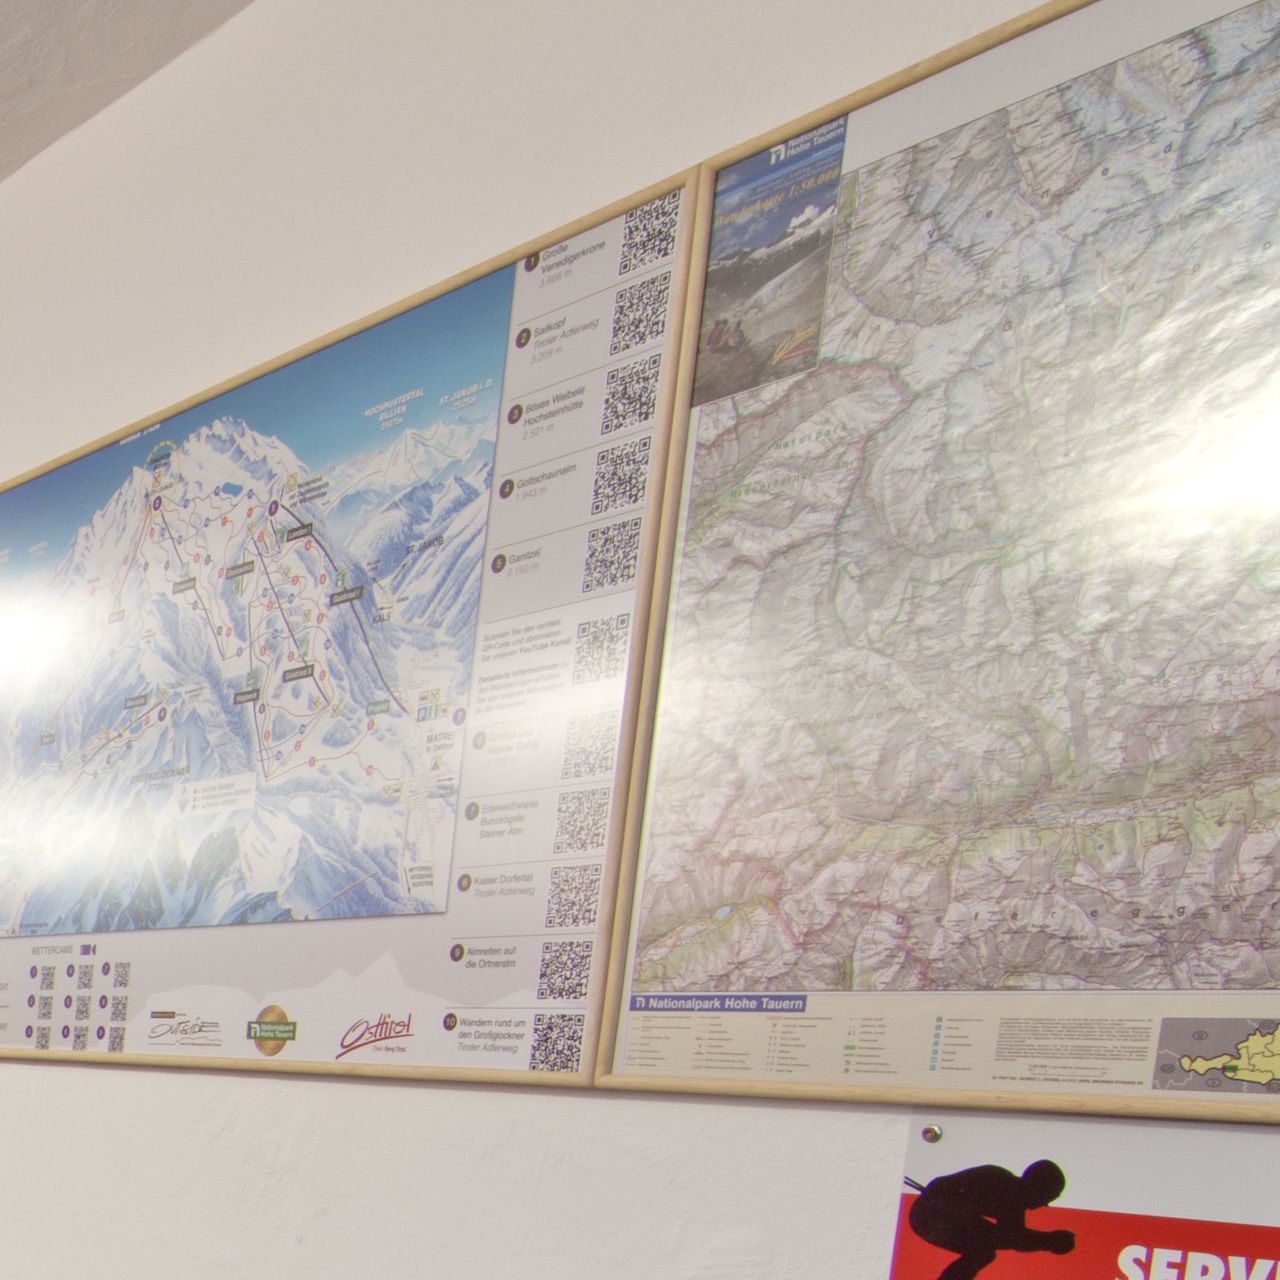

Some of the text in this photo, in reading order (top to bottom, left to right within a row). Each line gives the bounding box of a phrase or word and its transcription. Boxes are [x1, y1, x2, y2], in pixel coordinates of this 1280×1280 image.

[541, 241, 605, 273] Venedigerkrone
[542, 243, 568, 261] Große
[523, 400, 584, 428] Hochsteinhütte
[474, 875, 498, 886] Kaiser
[32, 945, 73, 955] WETTERCAMS
[466, 946, 516, 956] Almreiten auf
[465, 960, 477, 969] die
[648, 997, 804, 1010] Nationalpark Hohe Tauern
[460, 1018, 526, 1028] Wandern rund um
[340, 1013, 412, 1050] Osttirol
[458, 1030, 525, 1041] den Großglockner
[482, 1043, 519, 1055] Adlerweg
